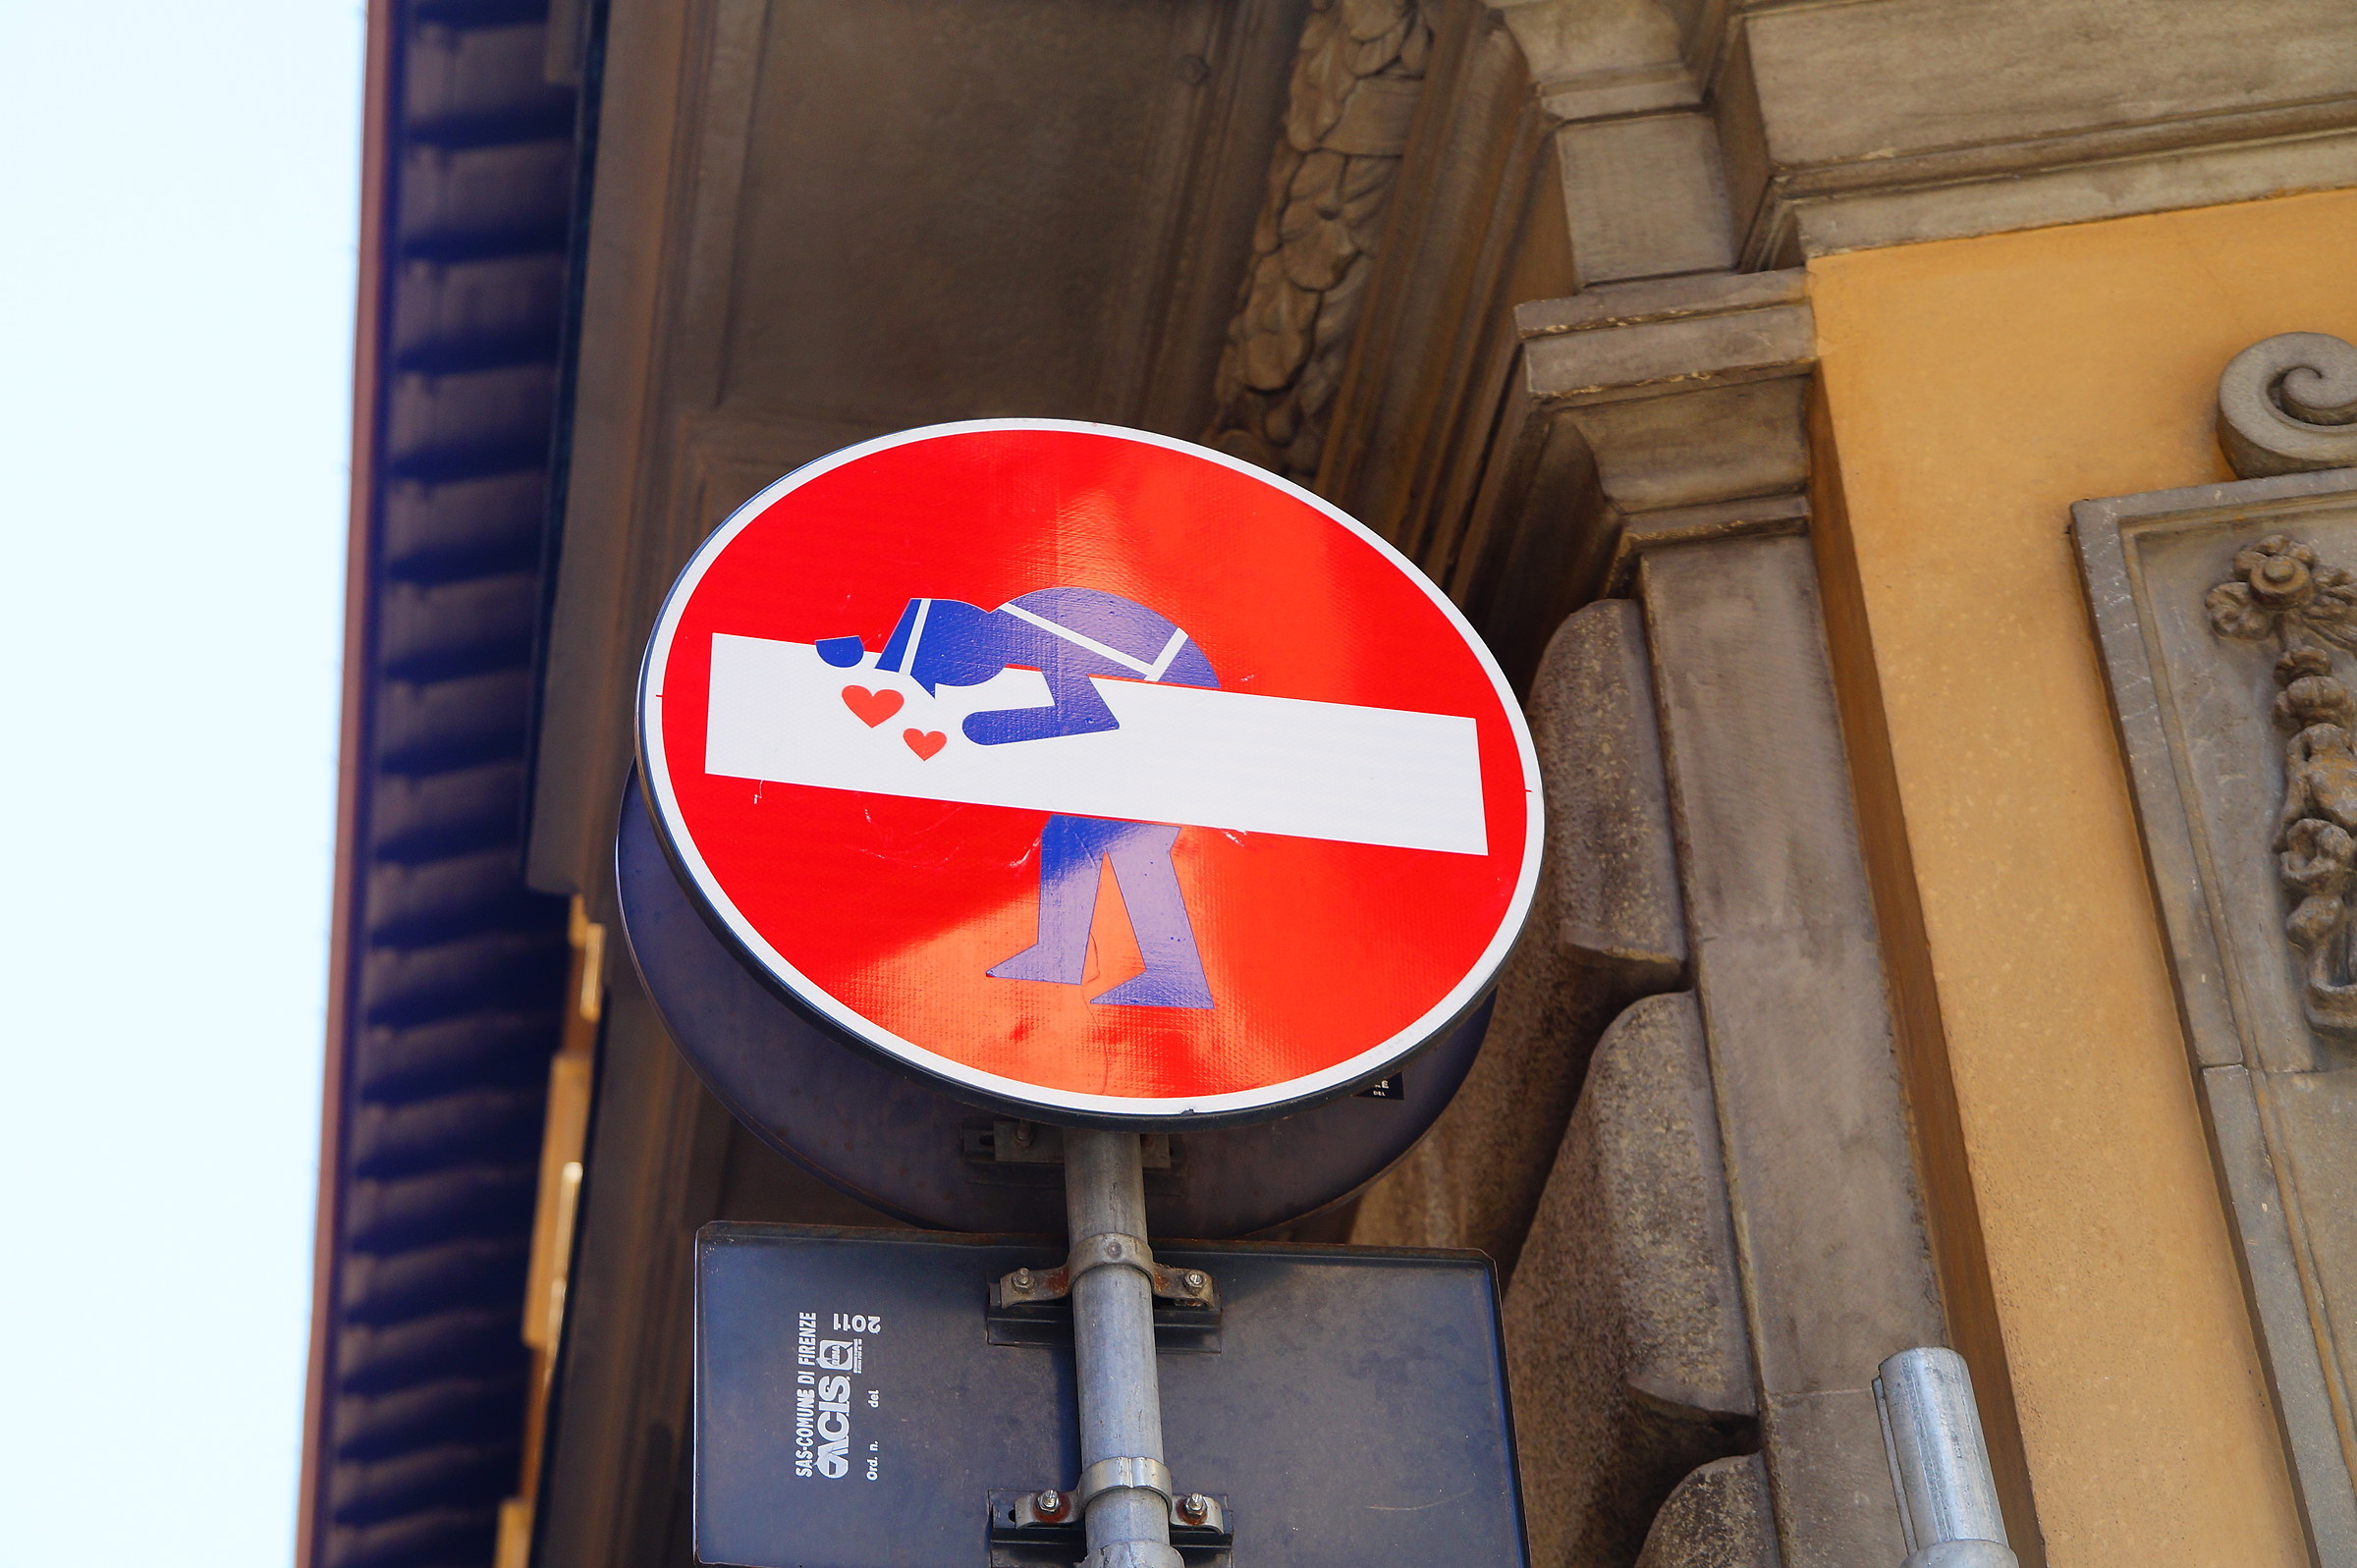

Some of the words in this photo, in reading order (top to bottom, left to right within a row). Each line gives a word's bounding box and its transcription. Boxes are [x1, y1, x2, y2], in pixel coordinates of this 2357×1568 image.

[833, 1313, 882, 1334] 2011
[798, 1312, 817, 1366] FIRENZE
[797, 1371, 815, 1385] DI
[867, 1389, 879, 1408] del
[795, 1388, 815, 1478] SAS-COMUNE
[869, 1440, 878, 1452] n.
[866, 1456, 878, 1481] Ord.
